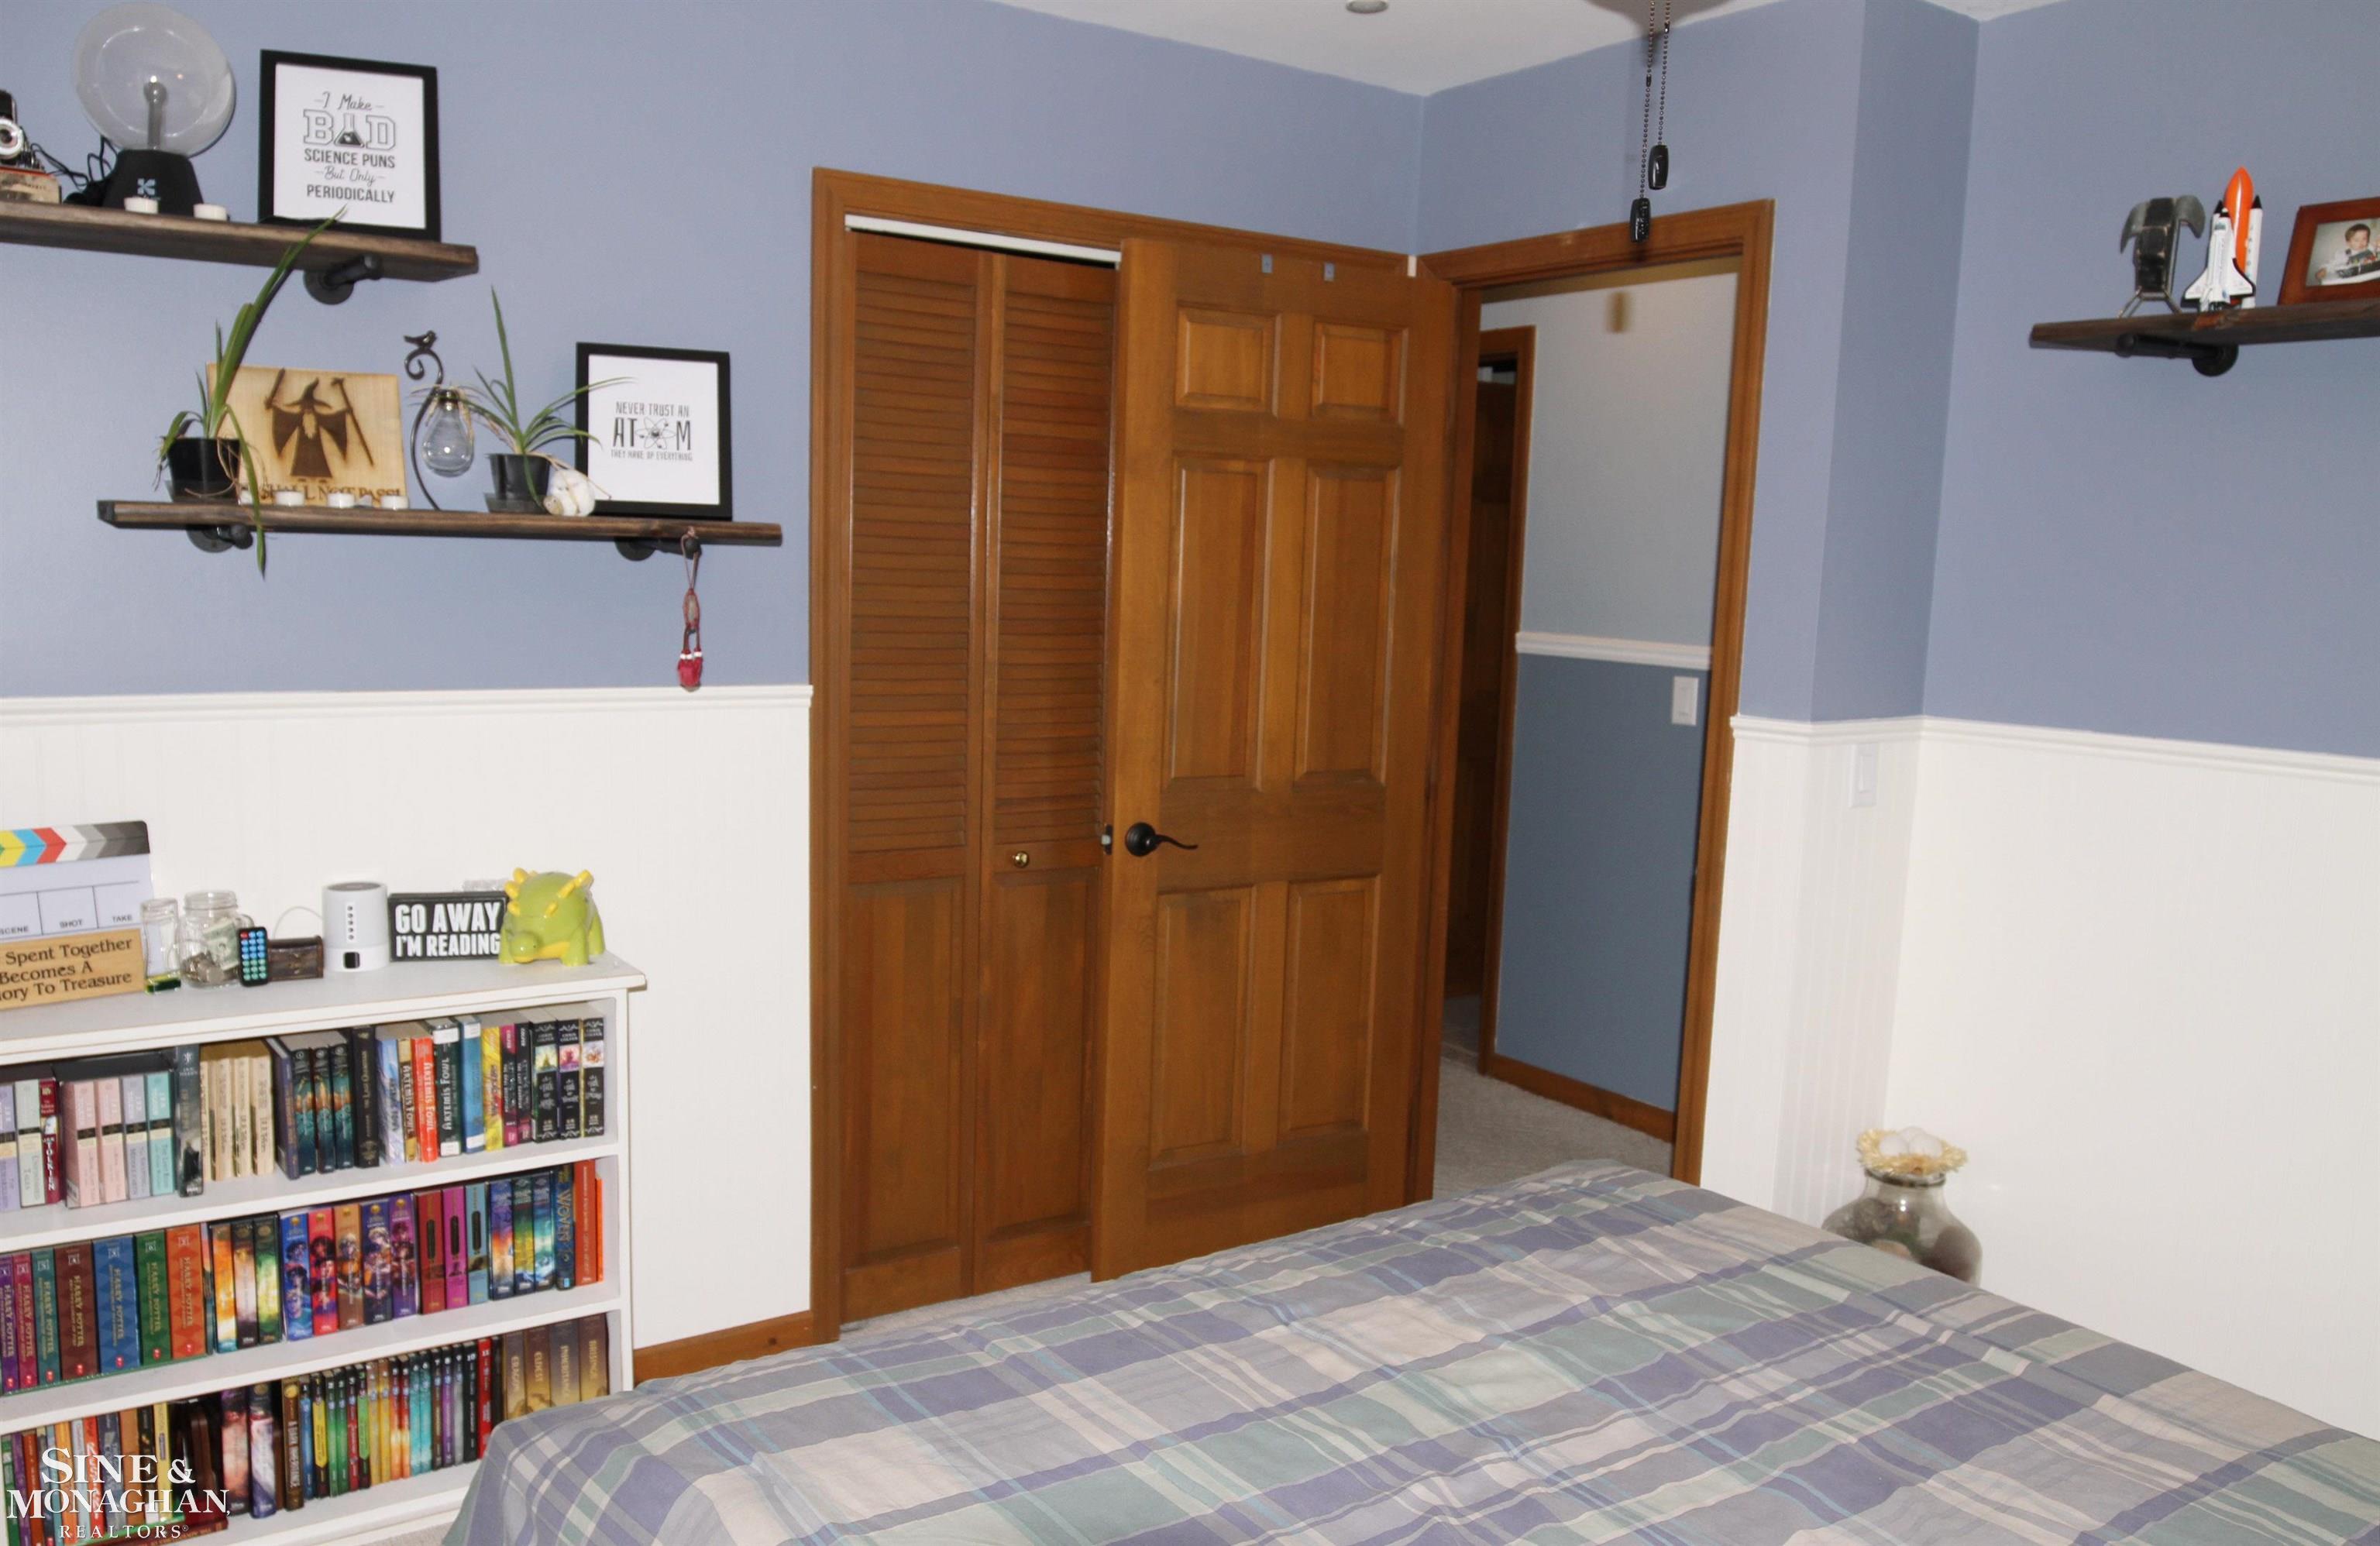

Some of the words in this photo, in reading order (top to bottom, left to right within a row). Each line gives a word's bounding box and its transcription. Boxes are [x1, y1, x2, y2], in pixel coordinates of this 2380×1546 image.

[338, 94, 373, 111] Make
[304, 148, 358, 166] SCIENCE
[363, 153, 395, 168] PUNS
[324, 166, 345, 180] But
[349, 168, 376, 186] Only
[307, 184, 394, 203] PERIODICALLY
[616, 401, 645, 415] NEVER
[648, 404, 674, 417] TRUST
[678, 405, 690, 417] AN
[611, 449, 625, 459] THEY
[656, 452, 693, 462] EVERYTHING
[60, 919, 83, 929] SHOT
[112, 914, 132, 922] TAKE
[394, 904, 426, 933] GO
[432, 902, 501, 933] AWAY
[5, 947, 55, 967] Spent
[60, 938, 132, 958] Together
[395, 934, 423, 958] I'M
[426, 933, 501, 957] READING
[0, 965, 76, 984] Becomes
[81, 960, 93, 974] A
[0, 987, 29, 1001] ory
[33, 983, 56, 996] To
[60, 973, 132, 991] Treasure
[440, 1057, 449, 1084] FOWL
[556, 1189, 571, 1243] WOVEN
[74, 1276, 83, 1309] HARRY
[113, 1268, 122, 1301] HARRY
[151, 1263, 160, 1295] HARRY
[4, 1284, 13, 1319] HARRY
[23, 1285, 33, 1319] HARRY
[43, 1281, 52, 1314] HARRY
[46, 1319, 54, 1353] POTTER
[76, 1313, 84, 1347] POTTER
[467, 1353, 476, 1362] 10
[534, 1352, 543, 1382] ELDEST
